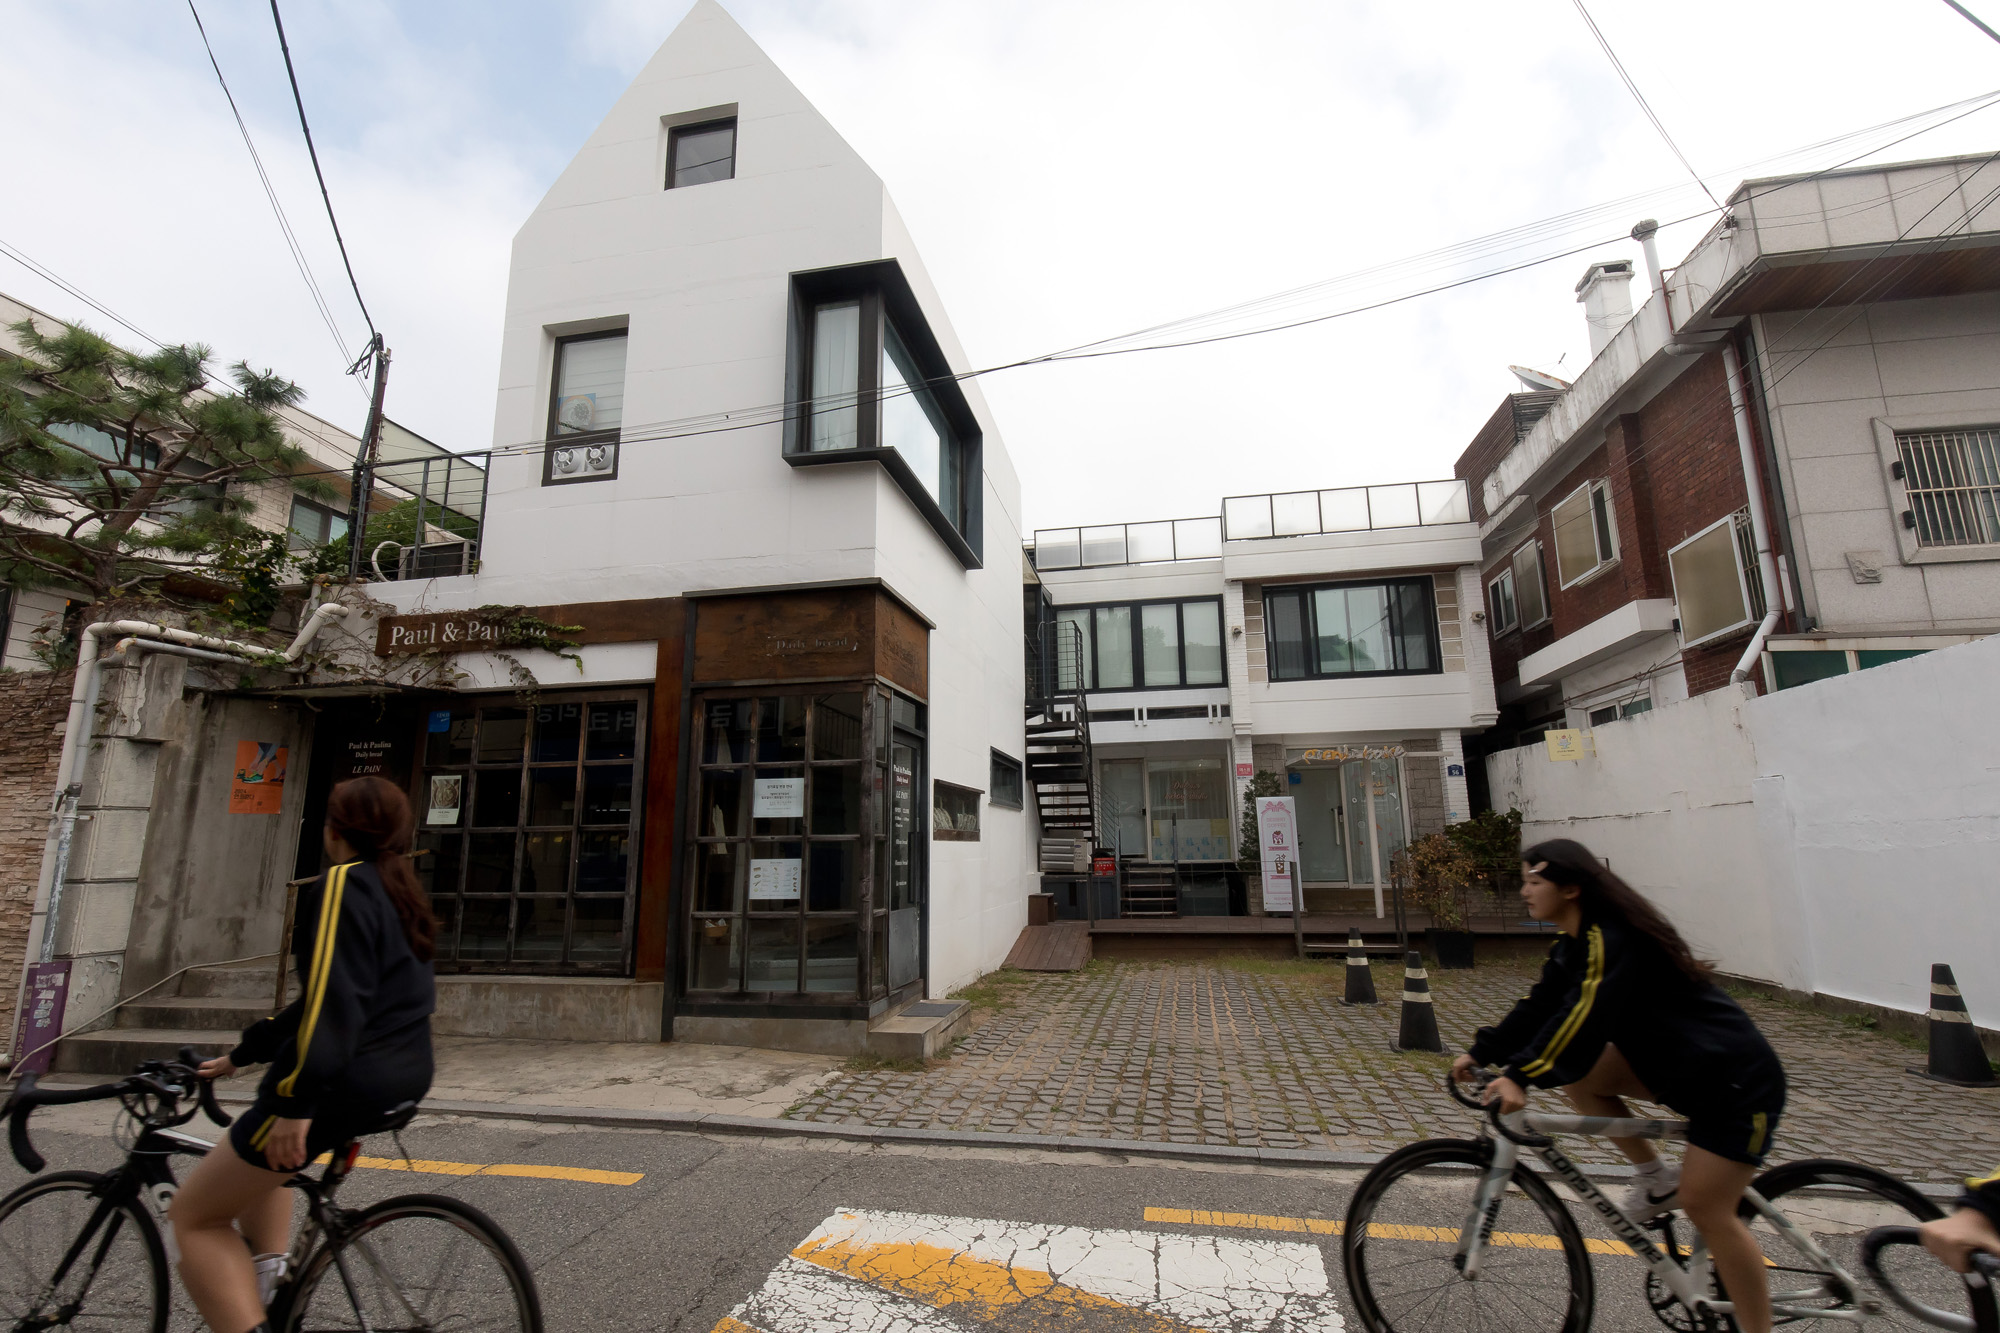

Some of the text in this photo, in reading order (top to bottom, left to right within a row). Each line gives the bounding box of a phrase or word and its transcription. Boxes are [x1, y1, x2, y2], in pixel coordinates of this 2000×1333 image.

[389, 622, 436, 646] Paul
[442, 622, 461, 642] &
[348, 742, 362, 750] Paul
[370, 741, 391, 749] Paulina
[352, 765, 381, 774] LE PAIN
